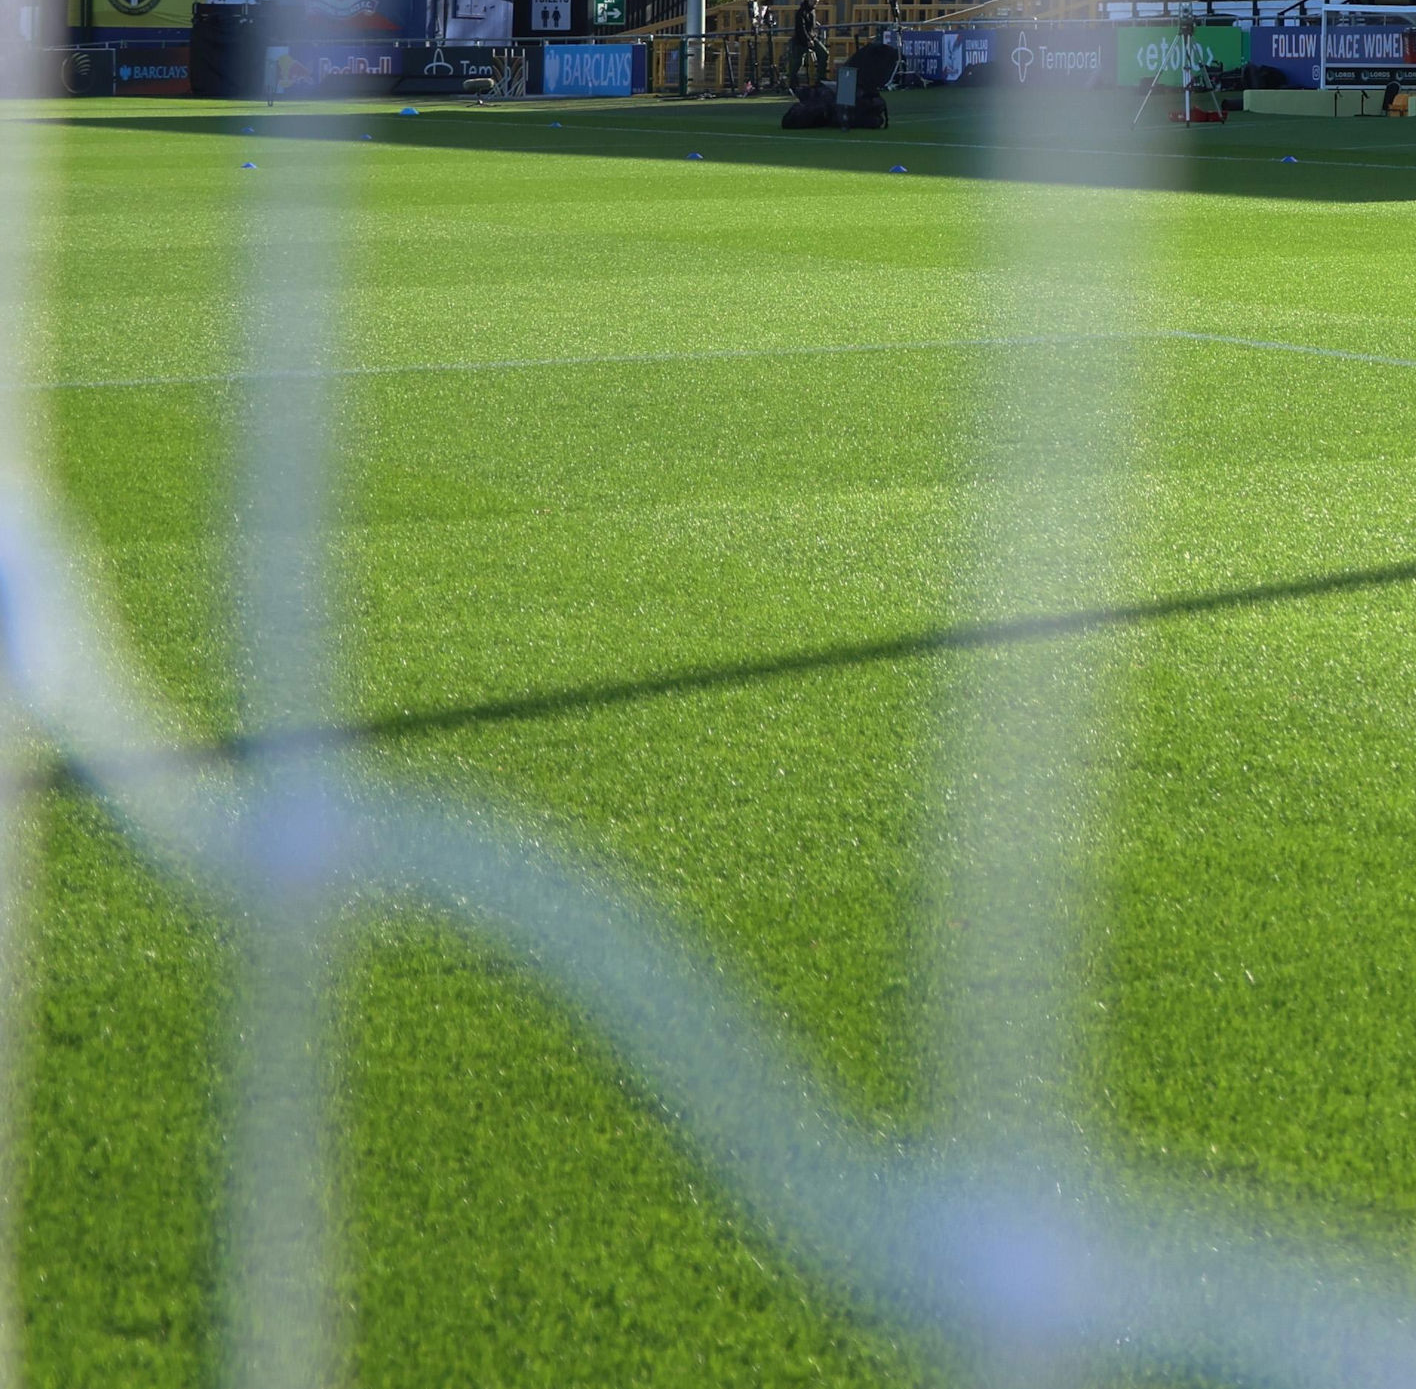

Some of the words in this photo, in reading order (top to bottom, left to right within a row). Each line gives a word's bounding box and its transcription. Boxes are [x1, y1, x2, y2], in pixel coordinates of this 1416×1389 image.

[1272, 33, 1316, 58] FOLLOW
[133, 65, 189, 79] BARCLAYS
[563, 53, 632, 87] BARCLAYS
[1039, 45, 1102, 75] Temporal
